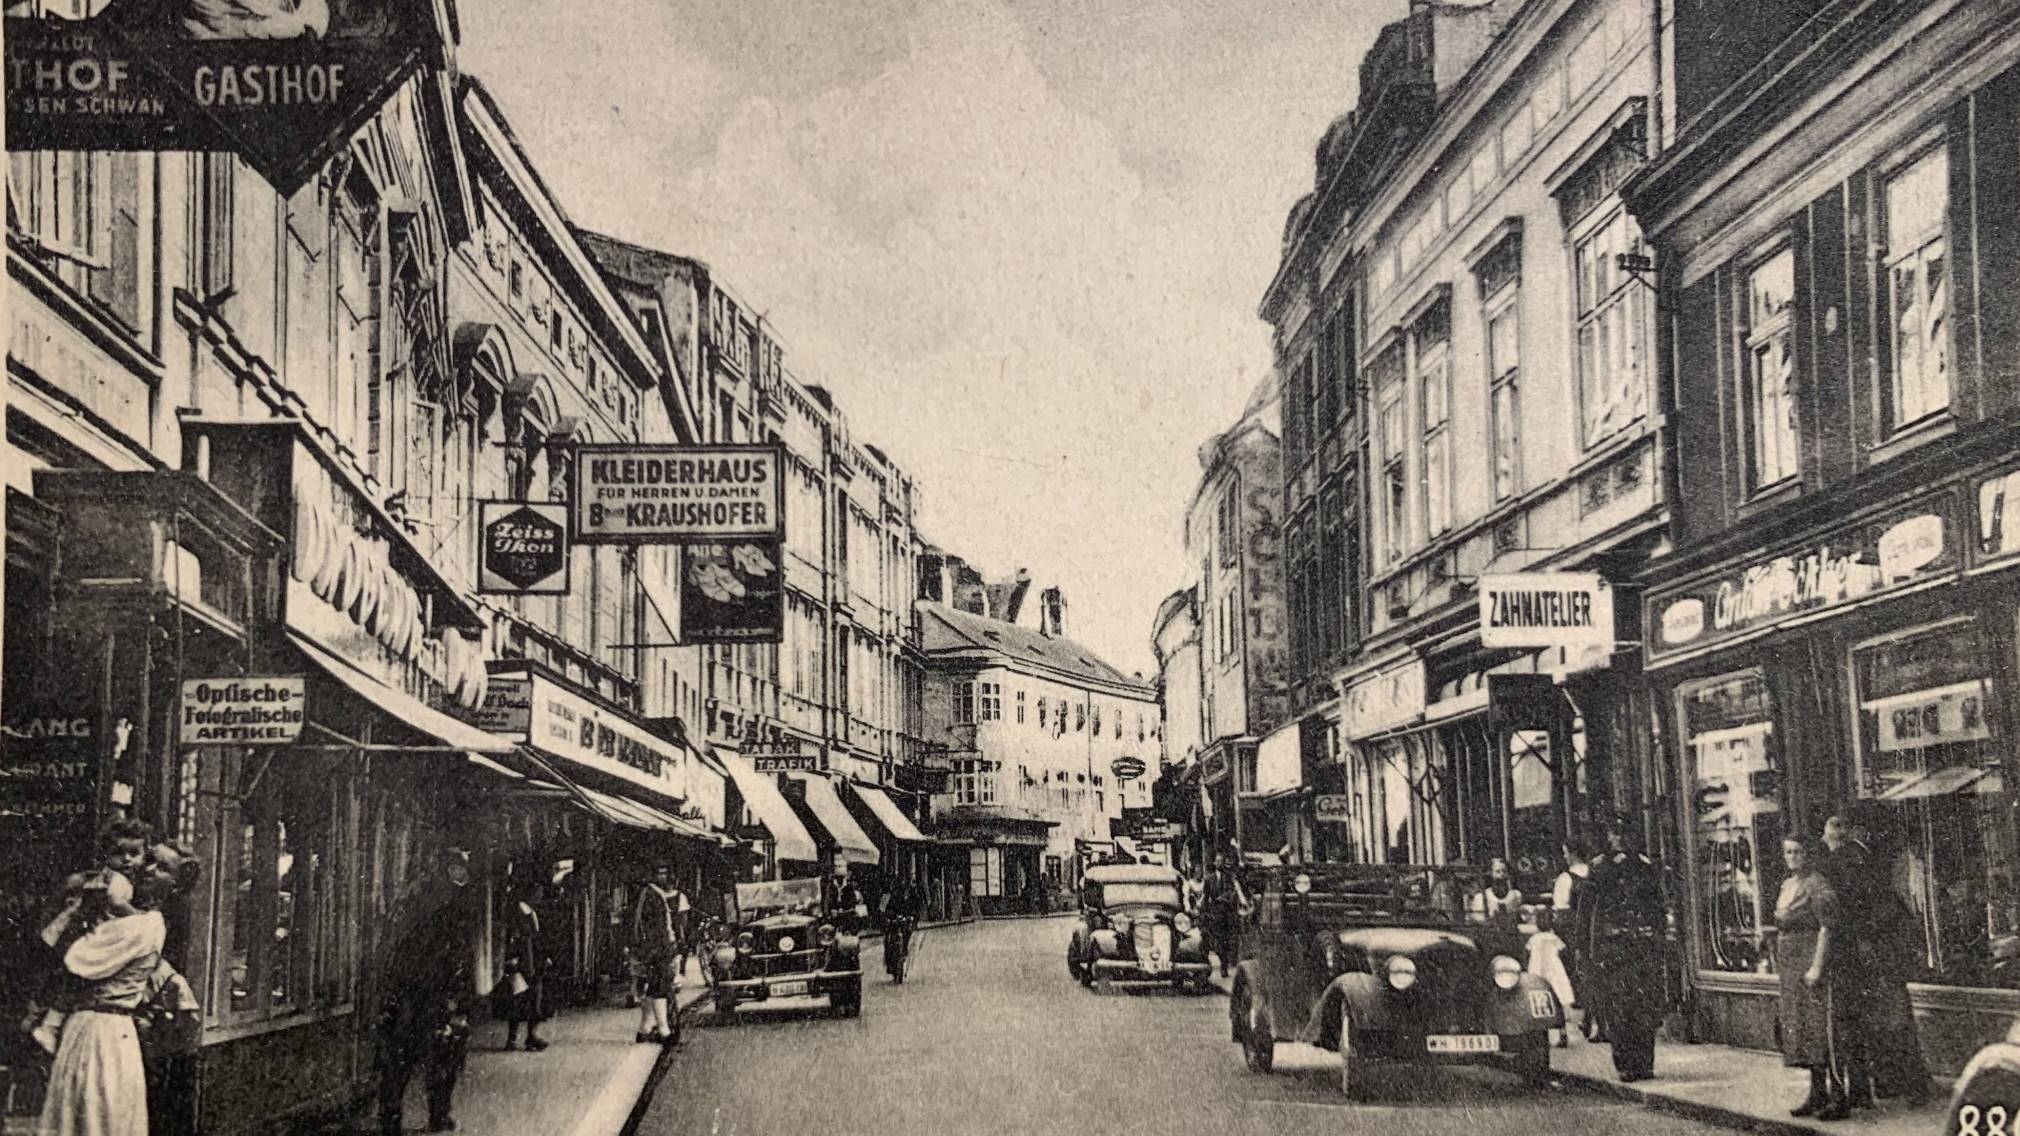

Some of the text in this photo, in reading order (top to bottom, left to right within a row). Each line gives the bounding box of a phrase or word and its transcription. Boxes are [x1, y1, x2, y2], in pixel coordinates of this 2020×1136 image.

[194, 63, 344, 106] GASTHOF
[591, 459, 767, 485] KLEIDERHAUS
[631, 486, 690, 498] HERREN
[709, 486, 759, 498] DAMEN
[626, 502, 767, 527] KRAUSHOFER
[494, 523, 555, 539] Zeiss
[495, 539, 554, 553] Ikon
[1489, 590, 1592, 627] ZAHNATELIER
[196, 727, 294, 739] ARTIKEL
[757, 760, 813, 770] TRAFIK
